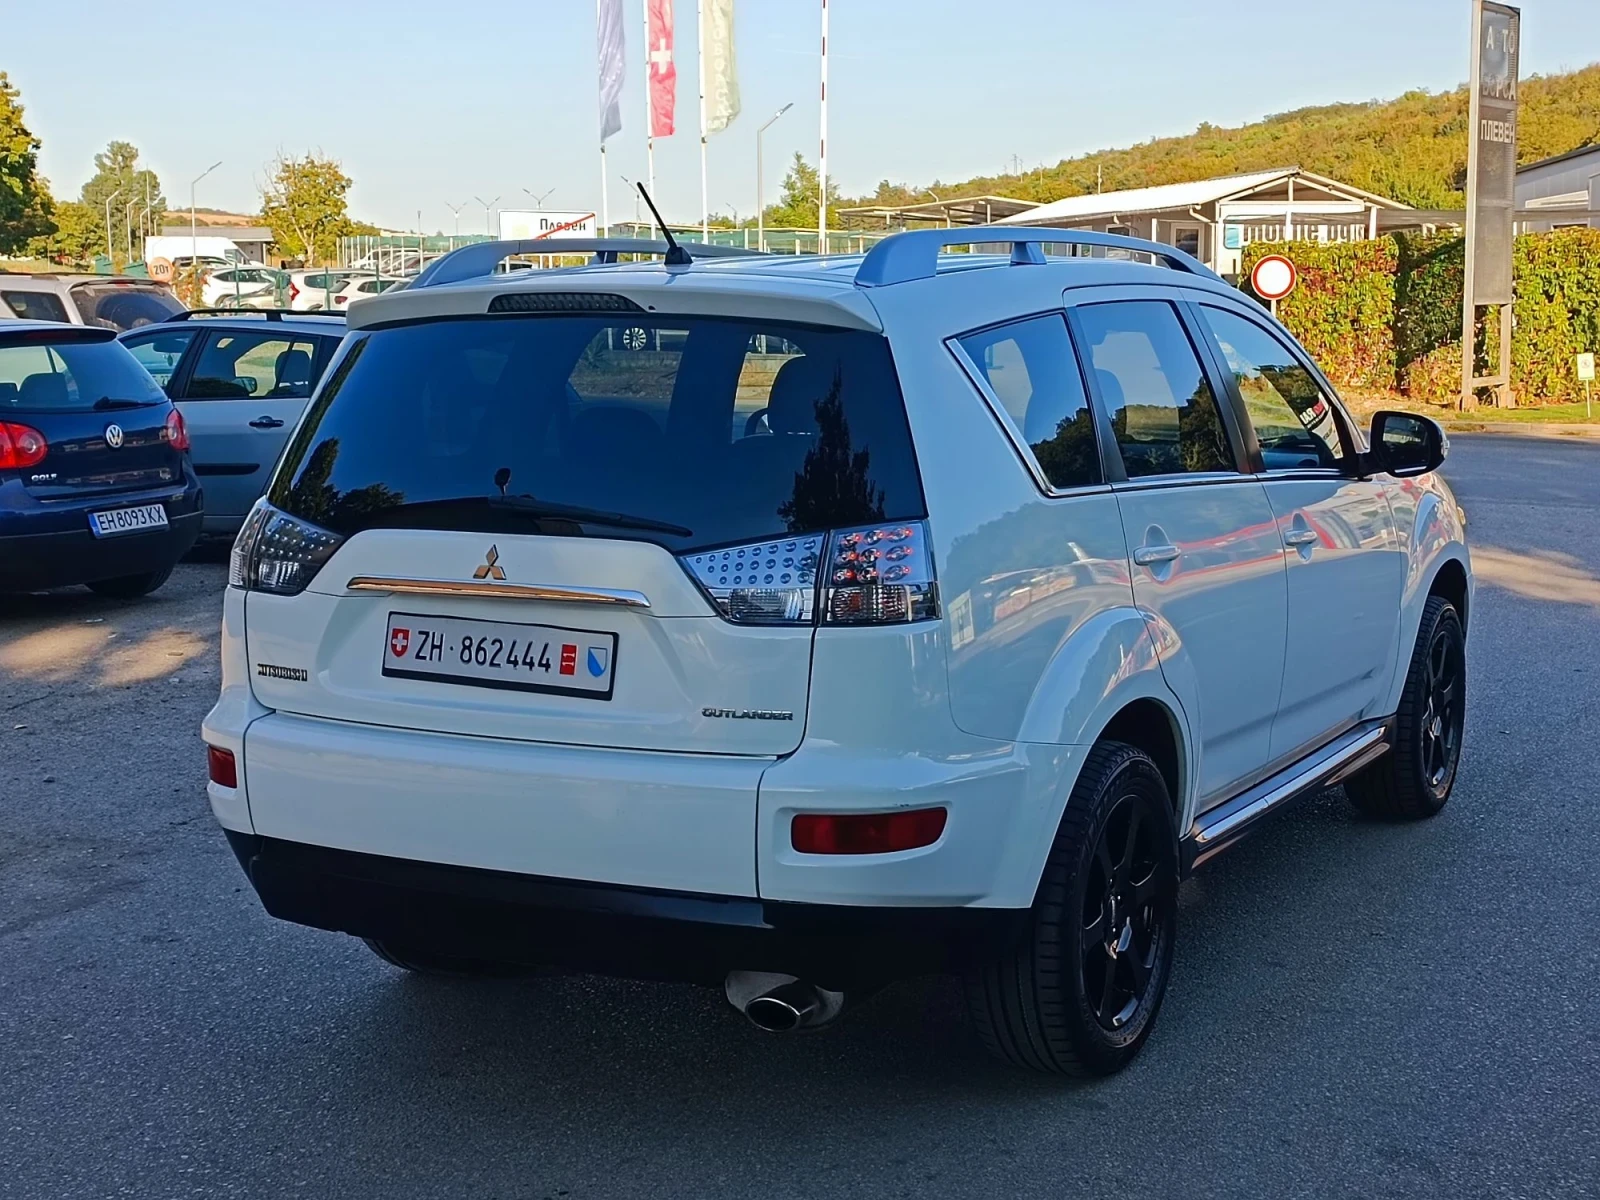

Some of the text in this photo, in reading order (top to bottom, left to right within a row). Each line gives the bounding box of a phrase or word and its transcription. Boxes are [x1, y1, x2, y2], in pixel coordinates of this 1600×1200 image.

[1486, 25, 1515, 53] АТО
[1480, 119, 1515, 143] ПЛЕВЕН
[540, 218, 586, 231] Плевен
[31, 473, 57, 482] GOLF
[459, 636, 551, 673] 862444
[701, 708, 793, 721] OUTLANDER
